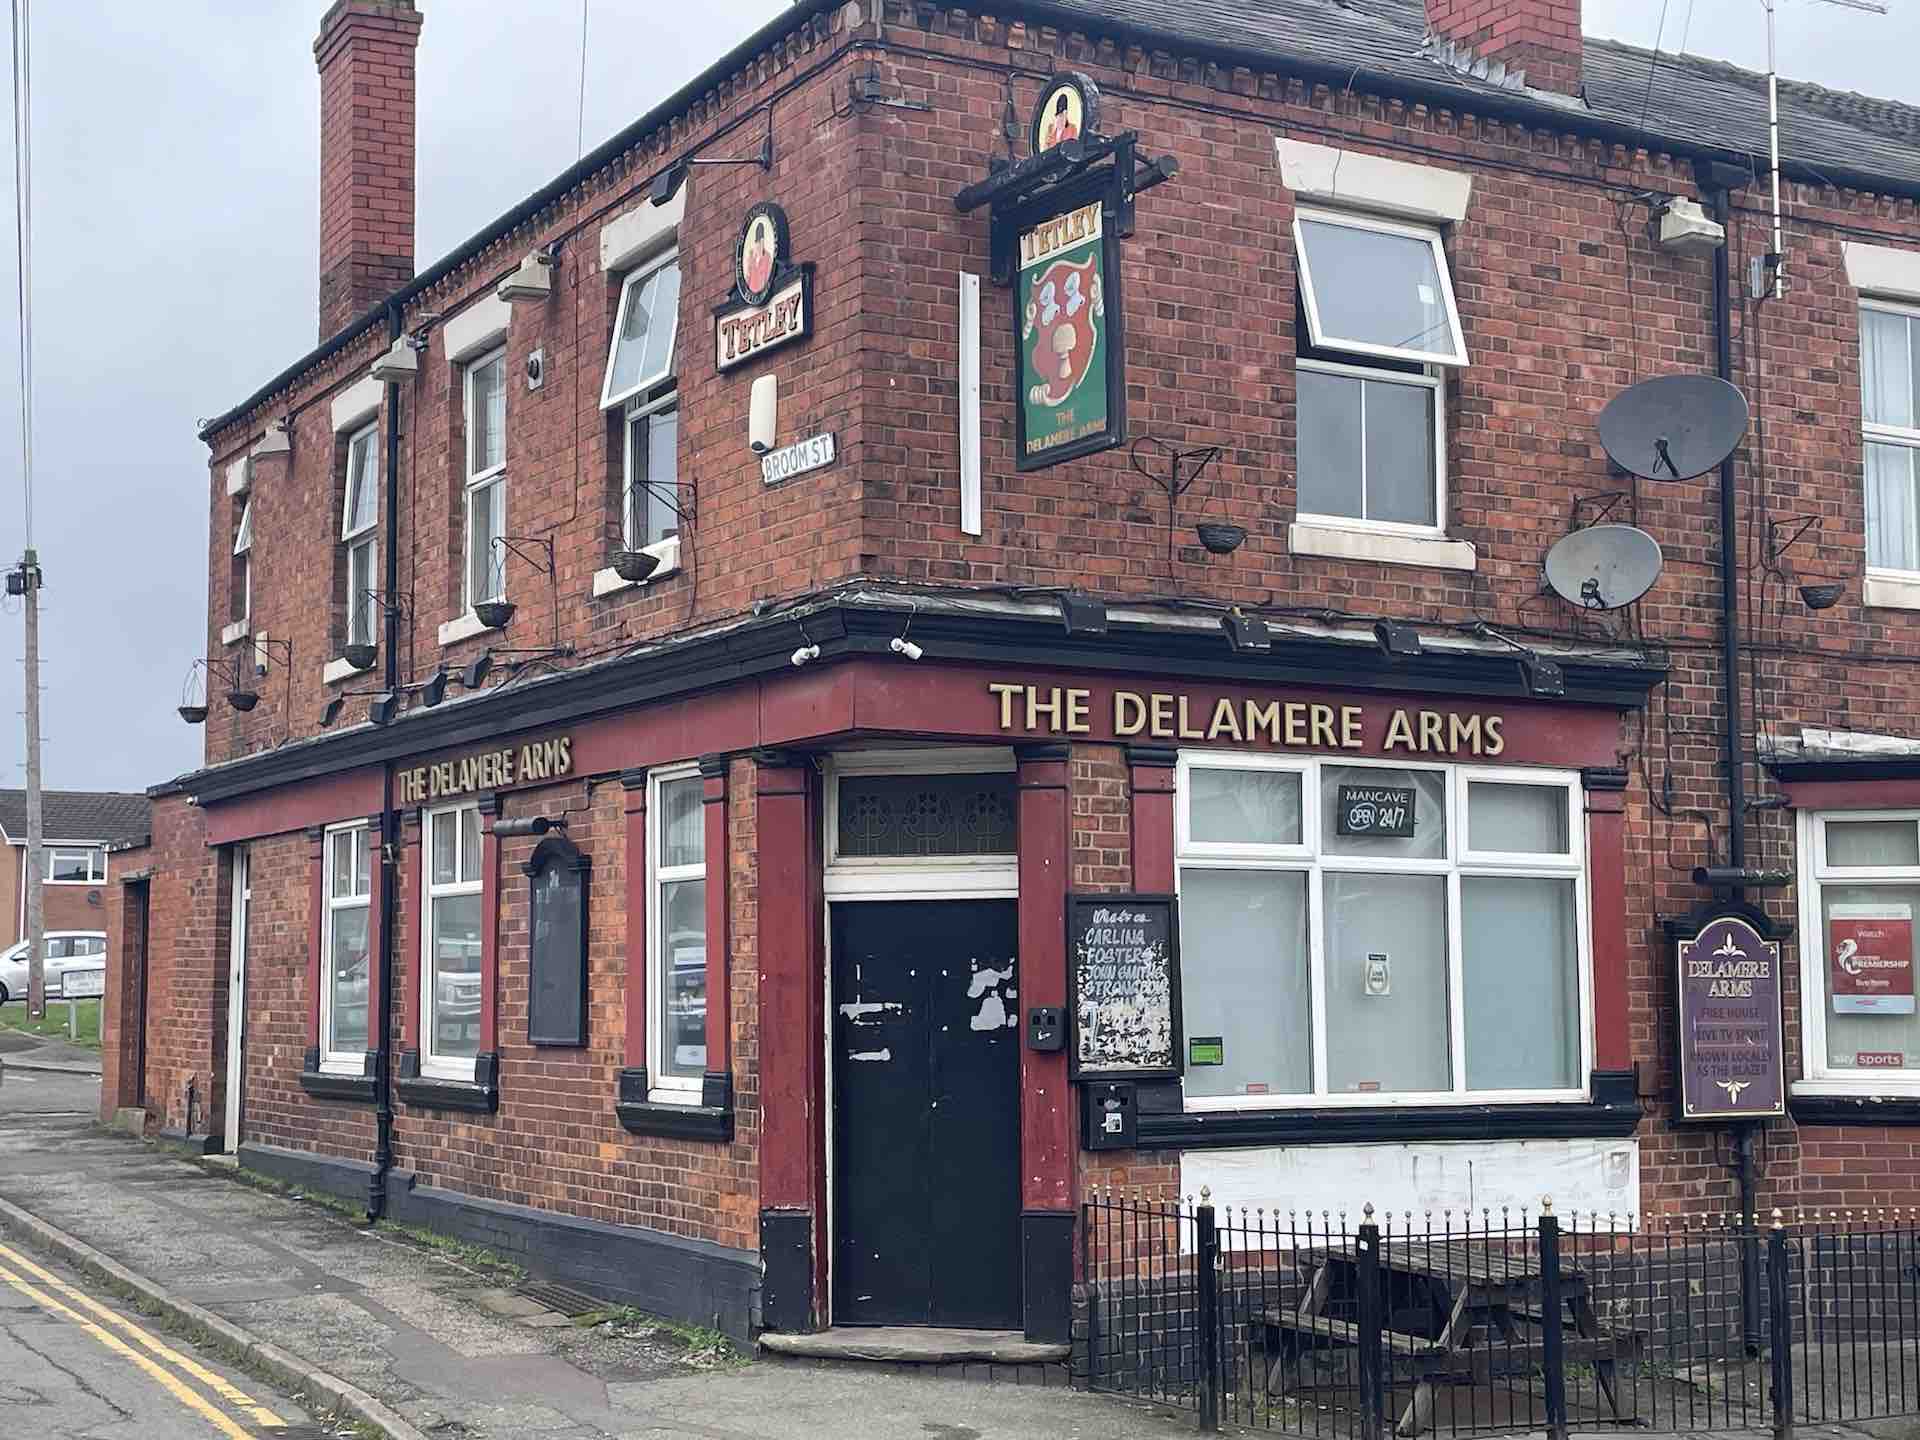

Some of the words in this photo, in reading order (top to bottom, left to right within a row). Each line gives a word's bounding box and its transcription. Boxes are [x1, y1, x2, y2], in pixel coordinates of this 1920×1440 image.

[1022, 205, 1098, 261] TETLEY
[722, 293, 801, 359] TETLEY
[765, 444, 808, 480] BROOM
[989, 684, 1090, 733] THE
[1114, 692, 1363, 749] DELAMERE
[1383, 709, 1504, 755] ARMS
[399, 767, 426, 803] THE
[430, 749, 513, 798] DELAMERE
[518, 737, 572, 780] ARMS
[1346, 791, 1408, 803] MANCAVE
[1350, 808, 1375, 824] OPEN
[1379, 806, 1405, 829] 24/7
[1857, 929, 1885, 938] Watch
[1087, 947, 1153, 964] FOSTERS
[1852, 960, 1909, 968] PREMIERSHIP
[1688, 961, 1769, 978] DELAMERE
[1708, 980, 1752, 998] ARMS
[1833, 1054, 1856, 1067] sky
[1858, 1054, 1900, 1066] sports
